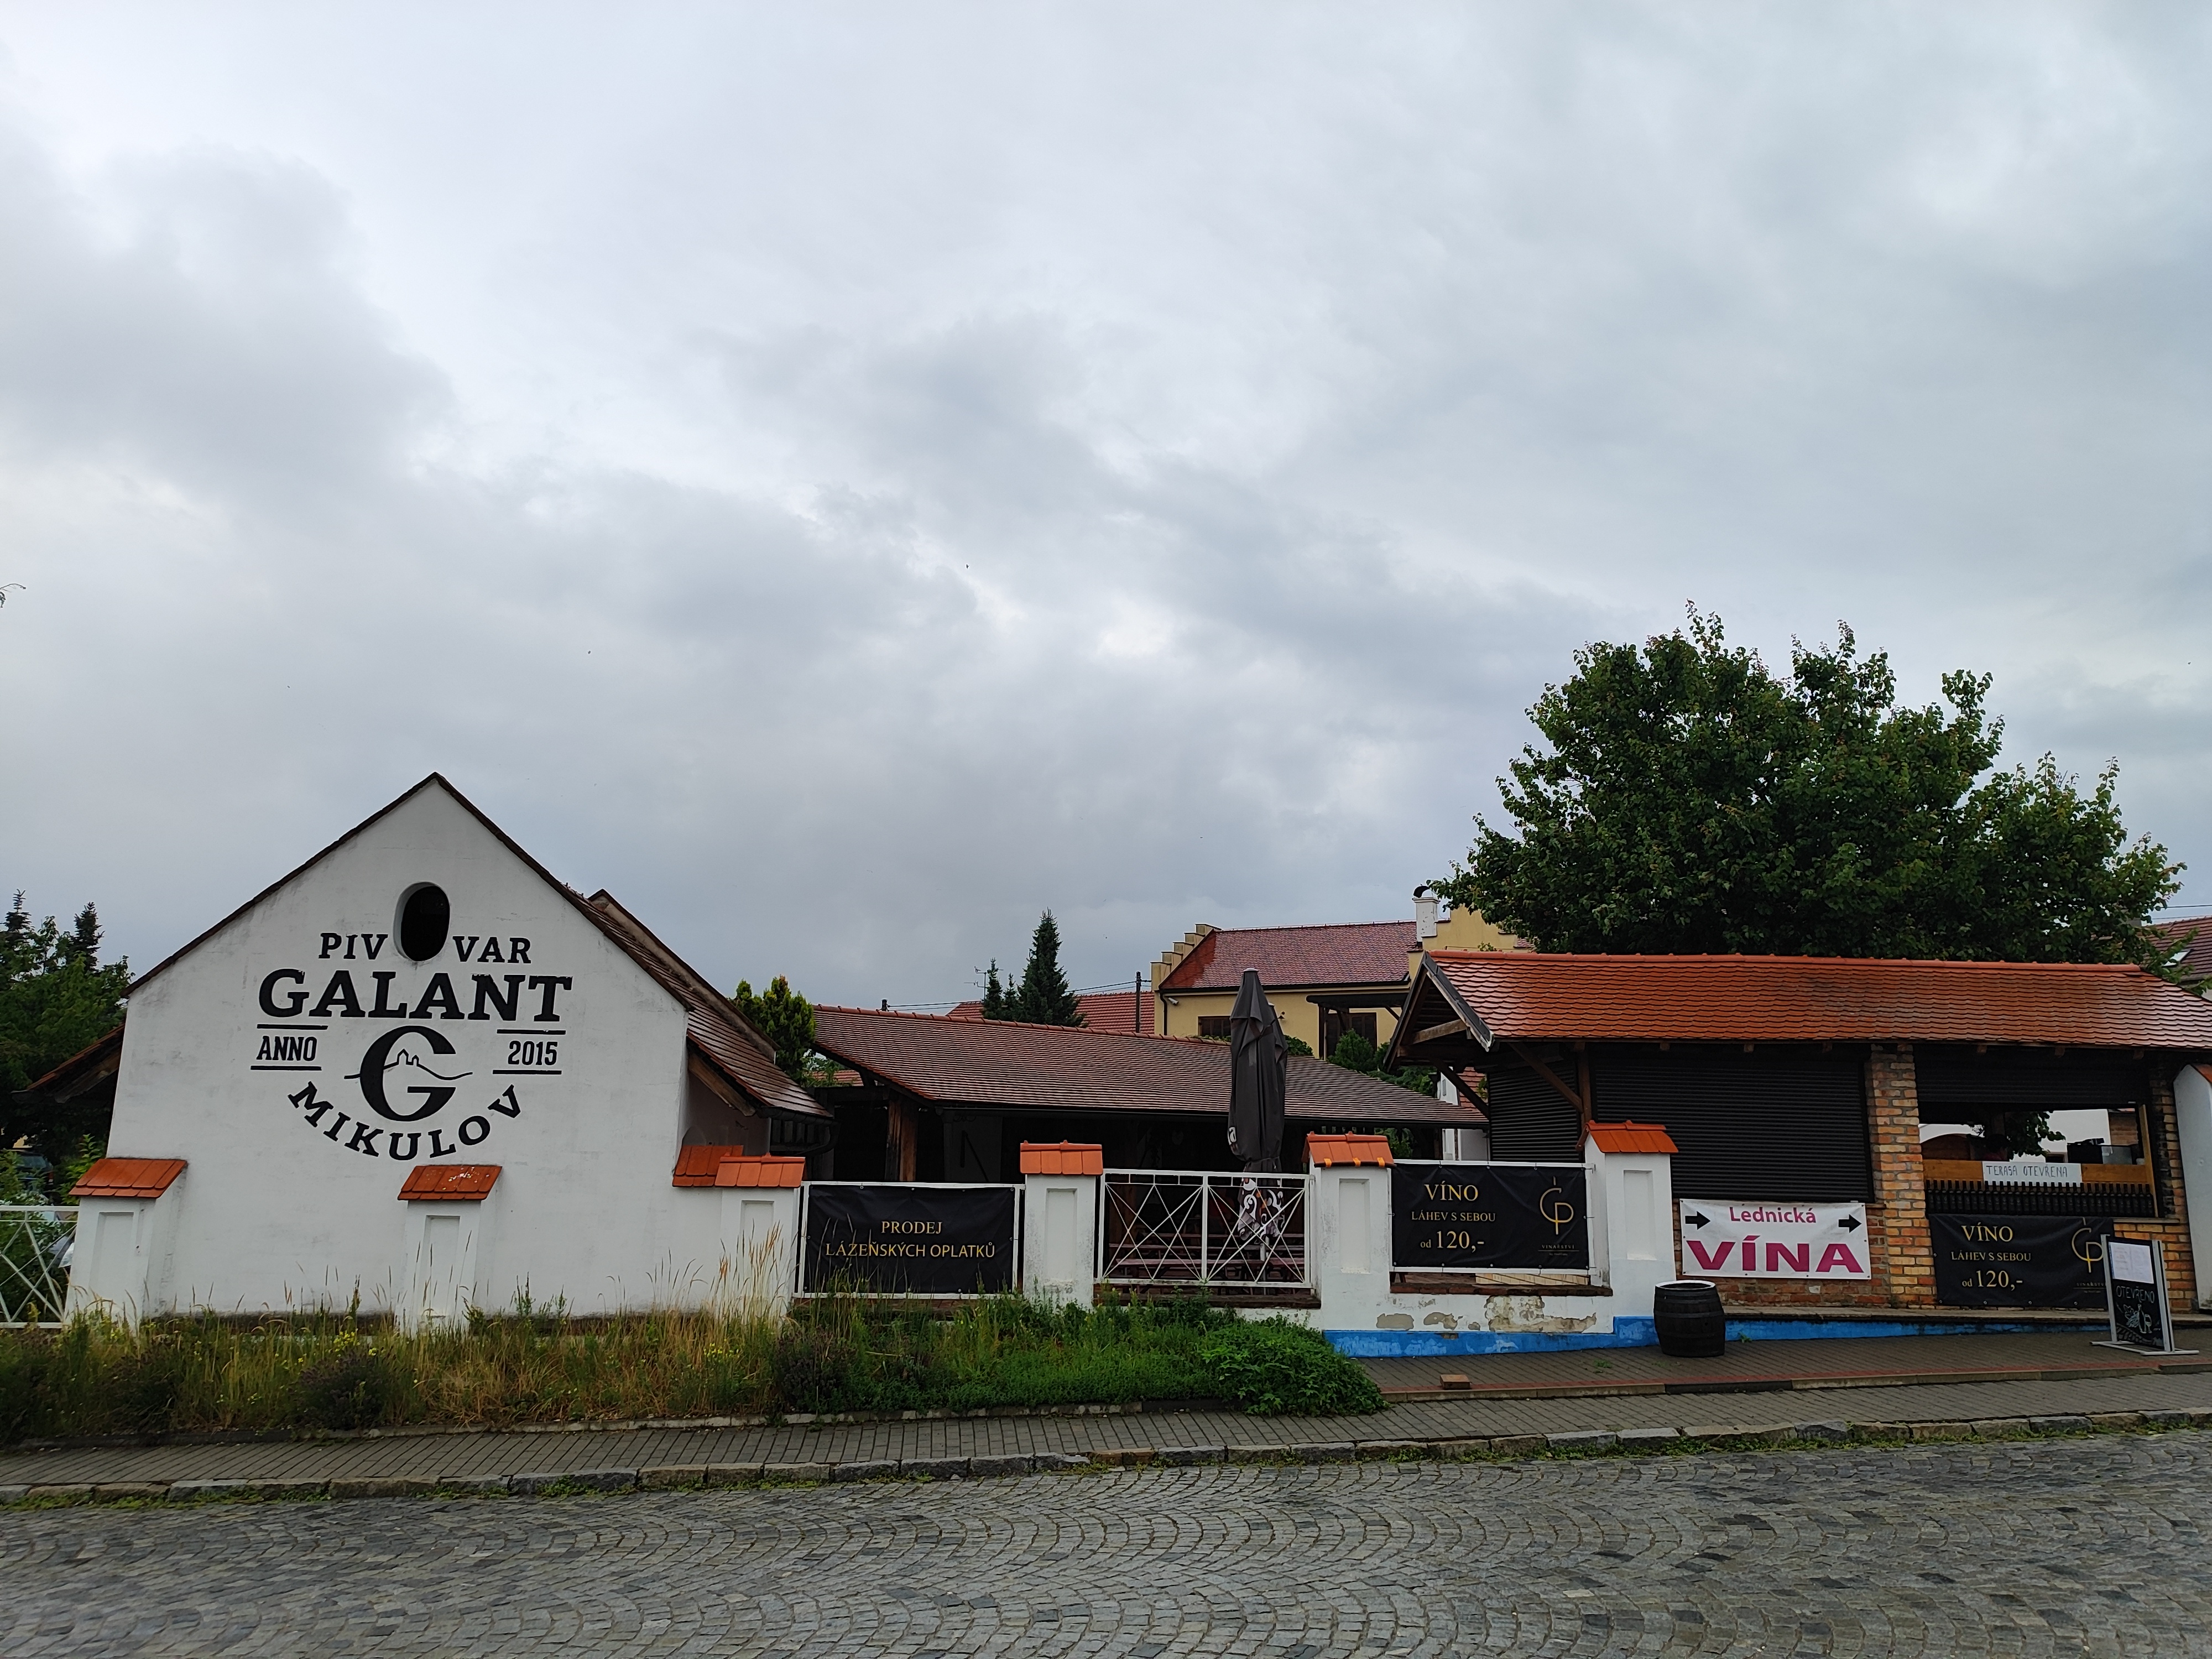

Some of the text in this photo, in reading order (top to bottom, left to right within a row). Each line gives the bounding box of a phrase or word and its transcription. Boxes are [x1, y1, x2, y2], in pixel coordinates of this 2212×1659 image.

[258, 968, 573, 1022] GALANT
[256, 1035, 317, 1061] ANNO
[507, 1040, 557, 1066] 2015
[288, 1081, 521, 1161] MIKULOV
[1986, 1165, 2068, 1178] TERASA OTEVŘENA
[1424, 1181, 1478, 1202] VÍNO
[1411, 1210, 1496, 1222] LÁHEV S SEBOU
[1729, 1207, 1816, 1223] Lednická
[881, 1221, 942, 1234] PRODEJ
[1961, 1222, 2013, 1242] VÍNO
[826, 1240, 995, 1258] LÁZEŇSKÝCH OPLATKŮ
[1420, 1230, 1484, 1252] od 120,-
[1686, 1235, 1864, 1273] VÍNA
[1951, 1250, 2031, 1261] LÁHEV S SEBOU
[1962, 1270, 2023, 1291] od 120,-
[2116, 1285, 2155, 1303] OTEVŘENO
